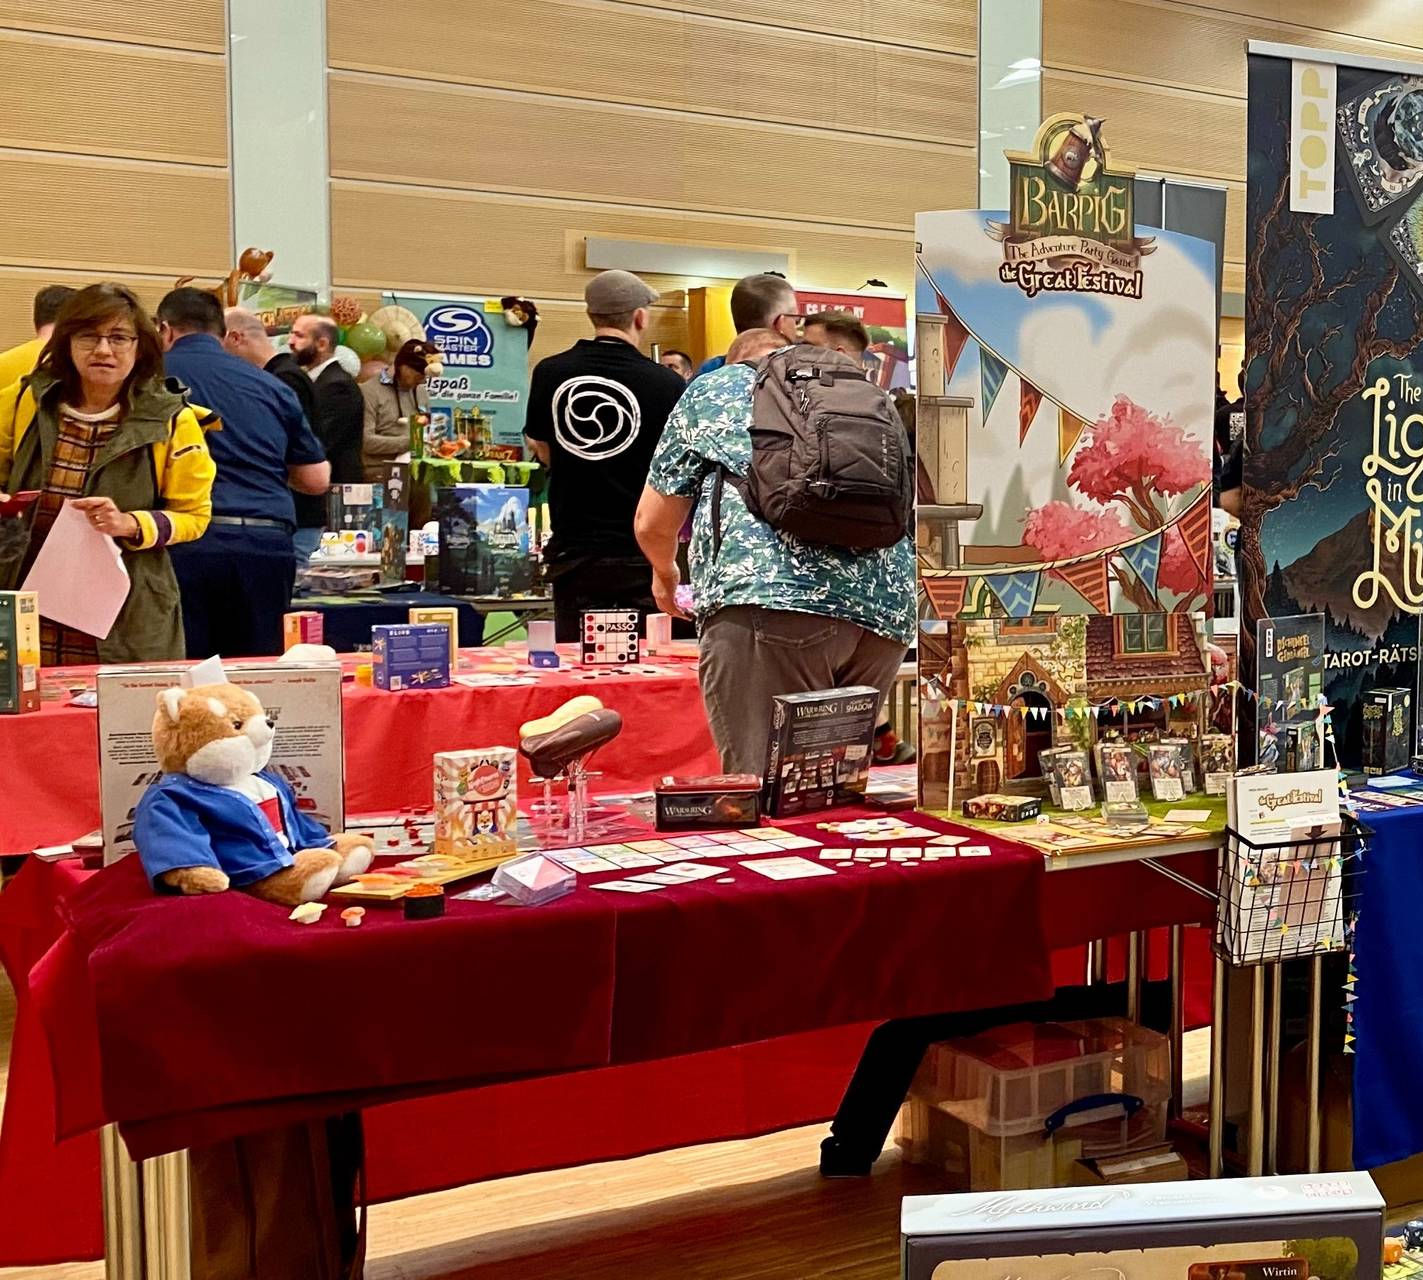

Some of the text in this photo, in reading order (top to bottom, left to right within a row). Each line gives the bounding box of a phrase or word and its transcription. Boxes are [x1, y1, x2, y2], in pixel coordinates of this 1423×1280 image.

[1300, 67, 1329, 200] TOPP
[1020, 176, 1126, 234] BARPIG
[1009, 239, 1136, 268] The Adventure Party Game
[1001, 261, 1142, 297] the Great Festival
[433, 335, 478, 346] SPIN
[442, 354, 491, 366] AMES
[427, 378, 468, 391] lspaß
[1393, 373, 1421, 404] The
[457, 393, 481, 401] ganze
[1387, 478, 1402, 503] in
[606, 623, 635, 631] PASSO
[846, 702, 873, 713] SHADOW
[1262, 1267, 1297, 1277] Wirtin
